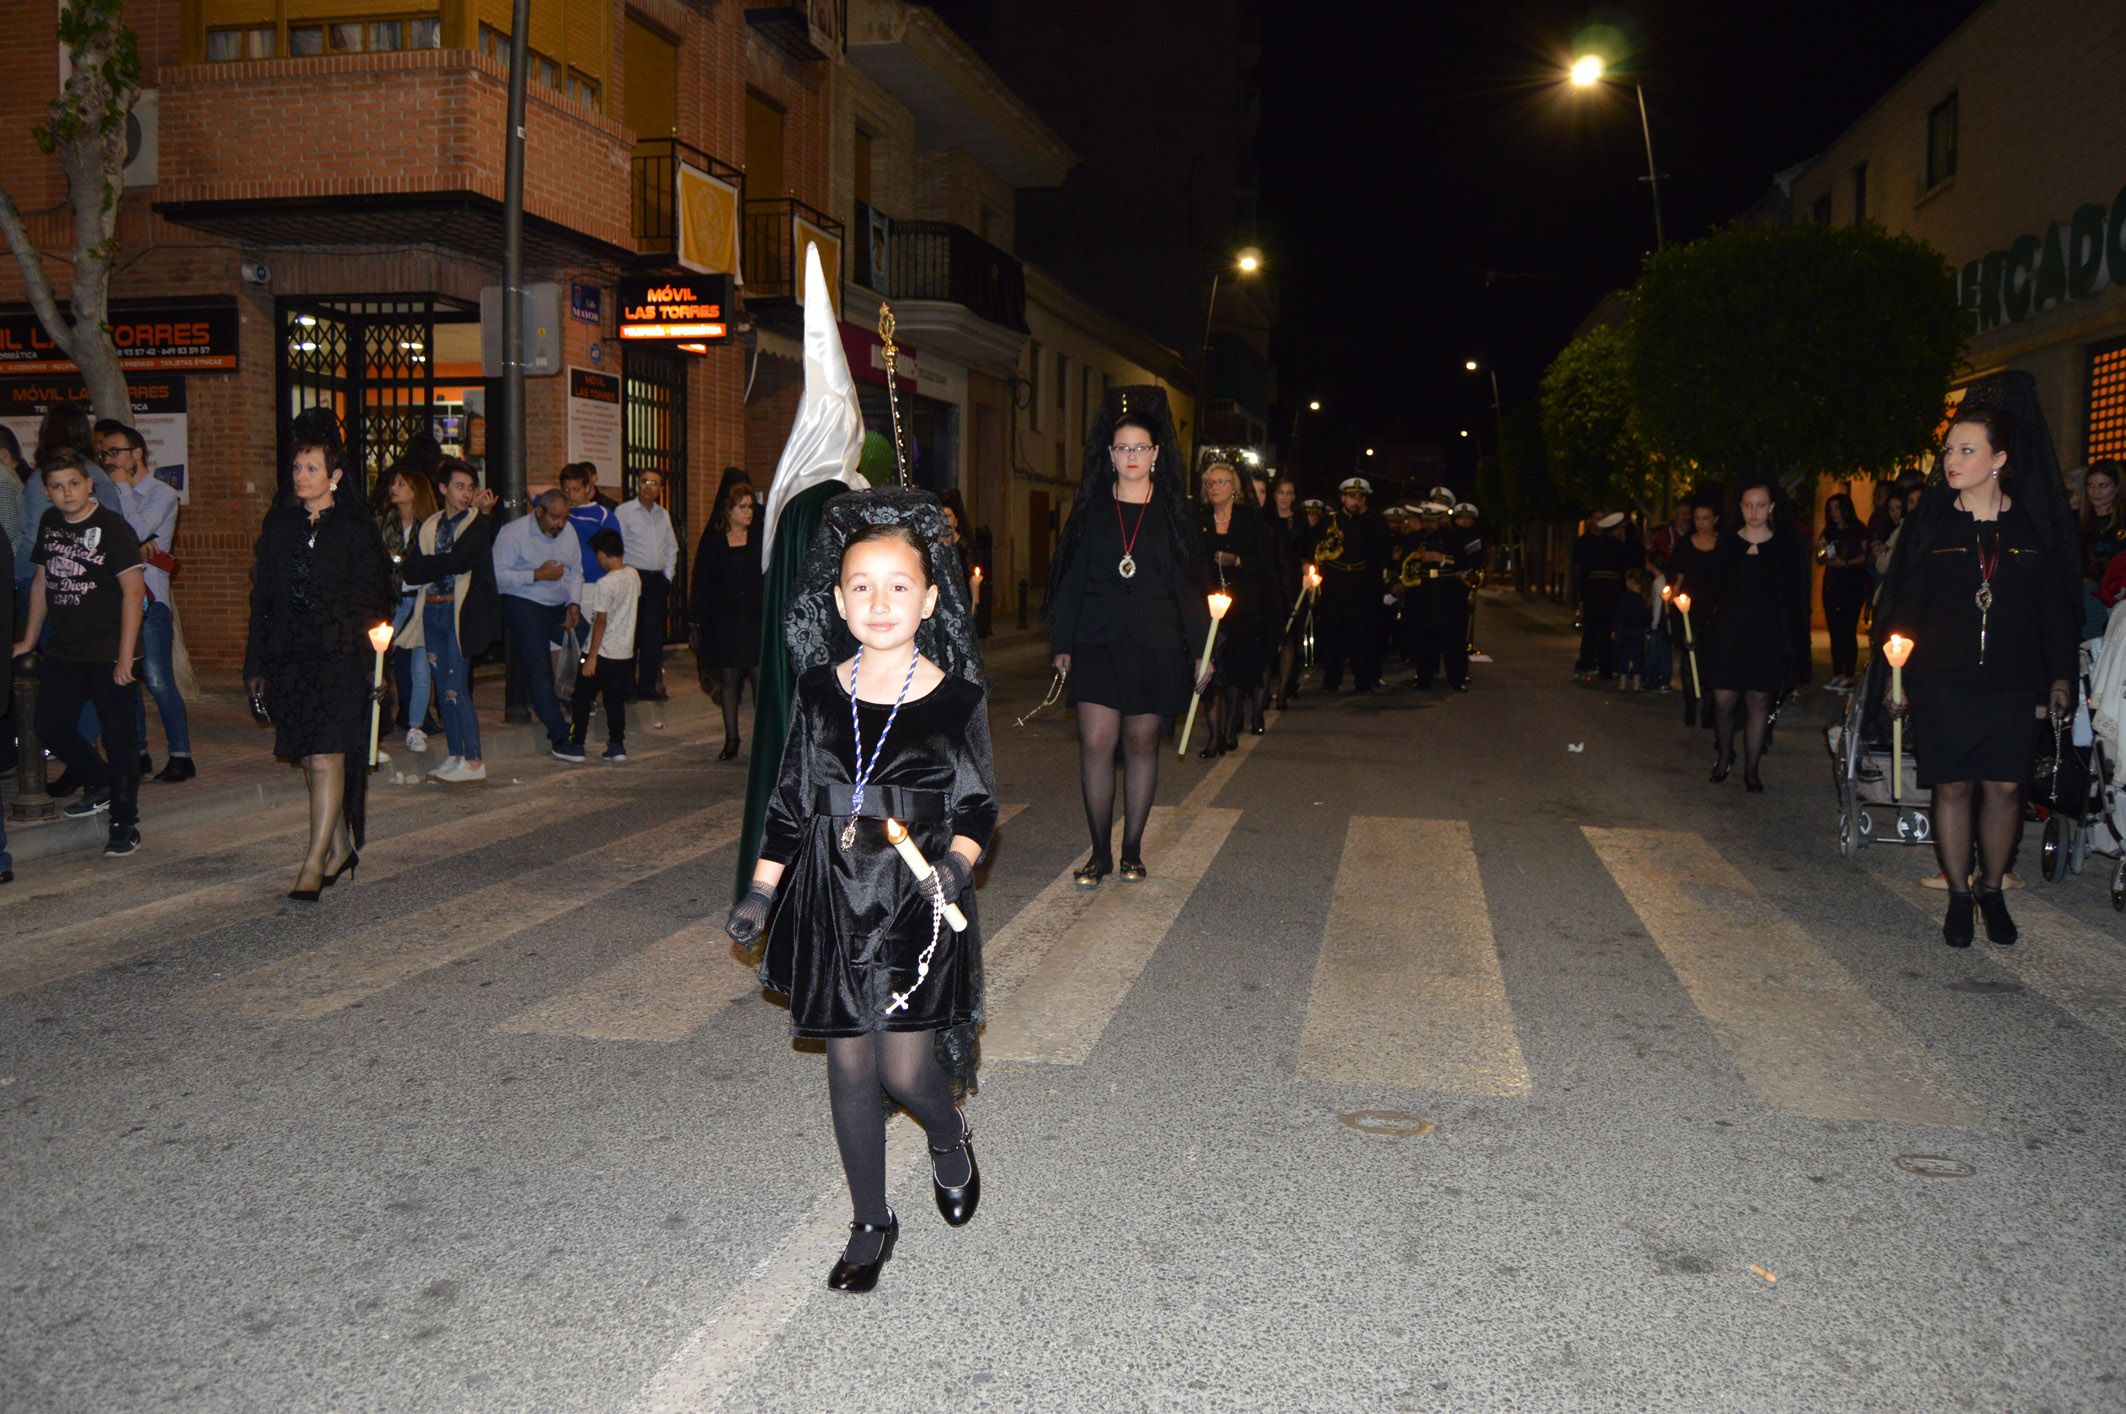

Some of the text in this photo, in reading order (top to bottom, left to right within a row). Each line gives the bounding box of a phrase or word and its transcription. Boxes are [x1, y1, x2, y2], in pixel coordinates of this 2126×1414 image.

[647, 285, 697, 303] MÓVIL
[573, 307, 599, 321] MAYOR
[625, 305, 720, 320] LAS TORRES
[109, 323, 210, 347] ORRES
[13, 385, 64, 401] MÓVIL
[68, 385, 91, 400] LA
[60, 578, 97, 595] Diego
